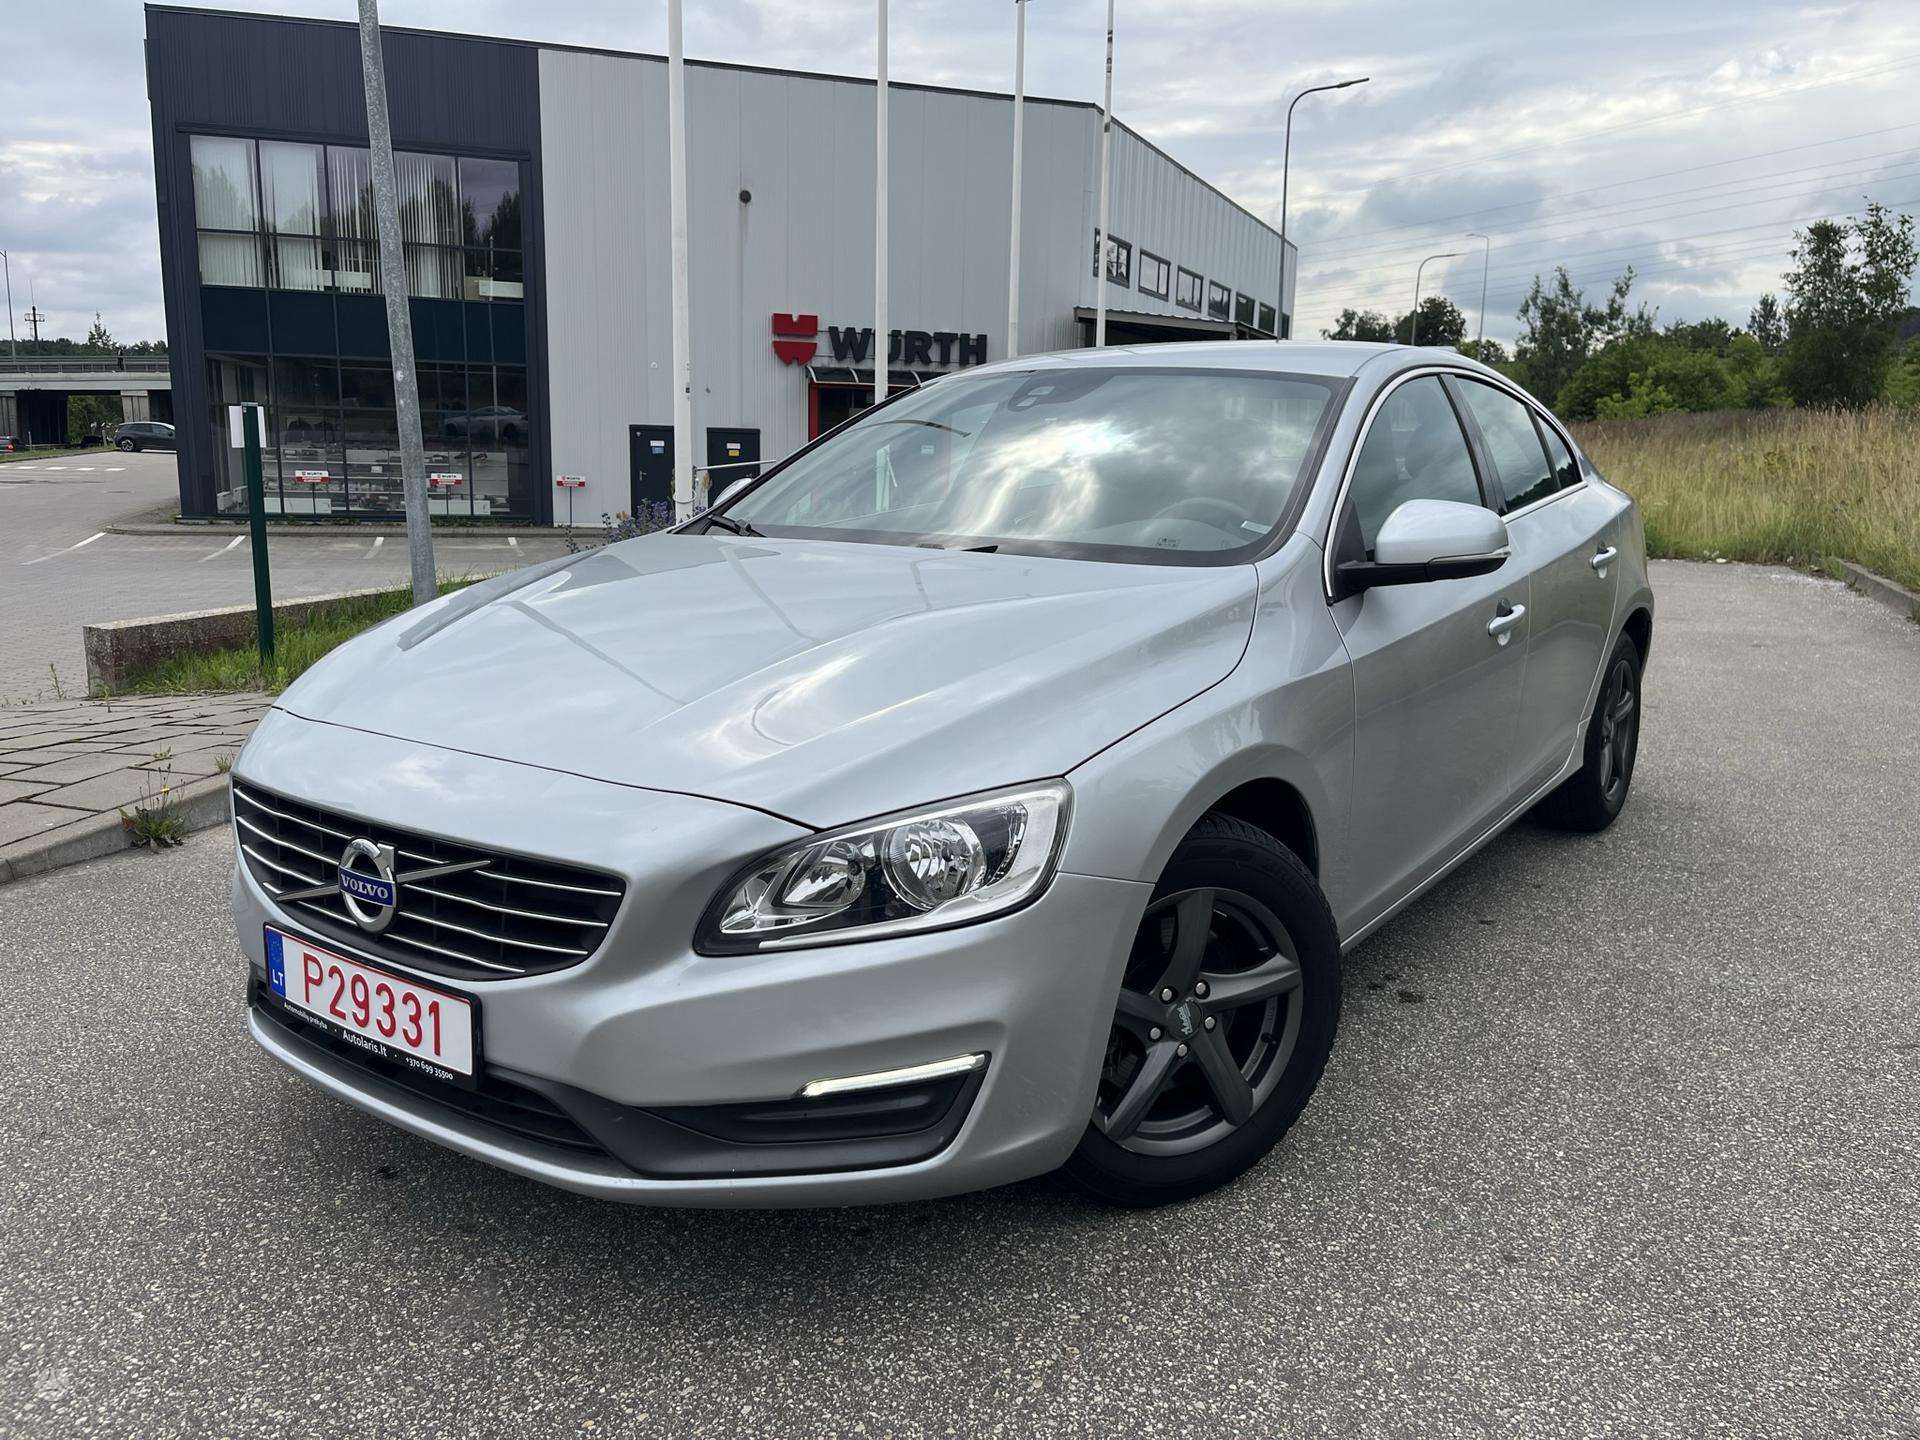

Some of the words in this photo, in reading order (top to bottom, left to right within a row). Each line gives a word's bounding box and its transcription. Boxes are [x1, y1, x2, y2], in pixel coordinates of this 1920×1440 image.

[341, 873, 389, 899] VOLVO
[272, 968, 284, 987] LT
[303, 952, 441, 1057] P29331
[342, 1030, 388, 1057] Autolaris.lt
[405, 1057, 420, 1069] +370
[420, 1060, 434, 1075] 699
